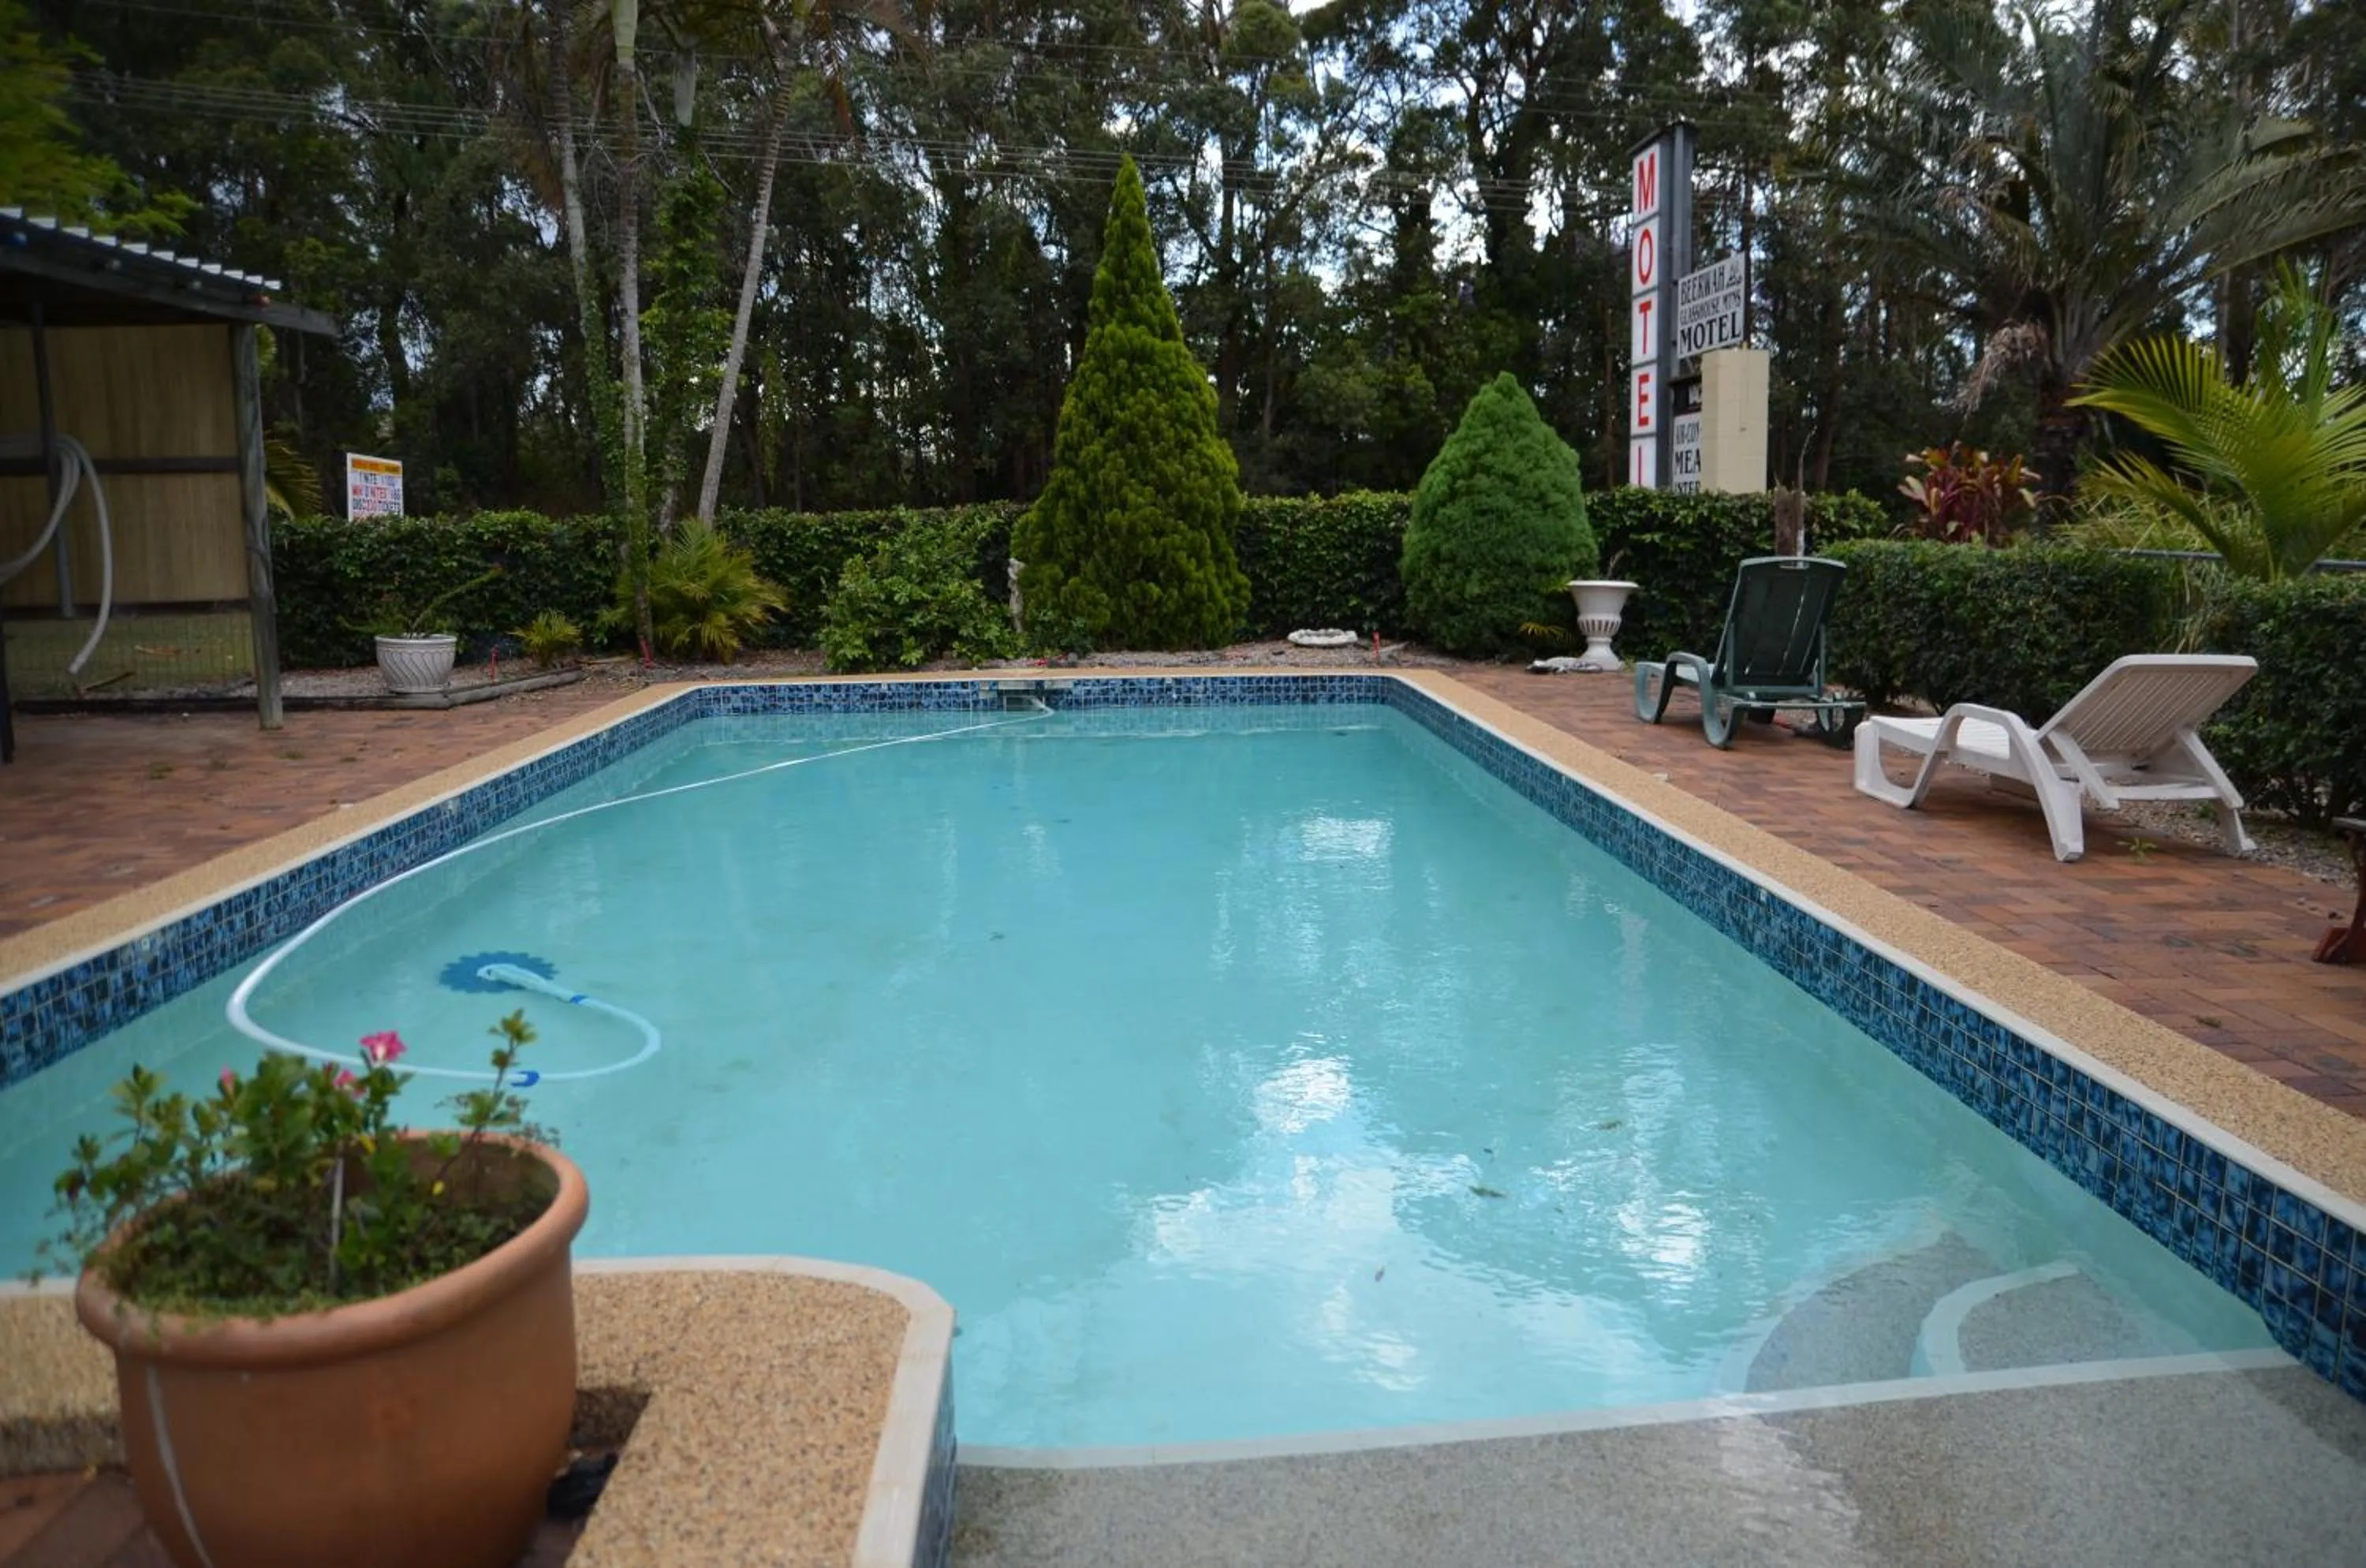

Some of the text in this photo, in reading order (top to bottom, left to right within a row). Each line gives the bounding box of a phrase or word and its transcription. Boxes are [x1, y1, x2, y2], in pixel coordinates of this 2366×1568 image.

[1681, 264, 1725, 305] BEERWAH
[1680, 295, 1719, 325] GLASSHOUSE
[1680, 312, 1741, 354] MOTEL
